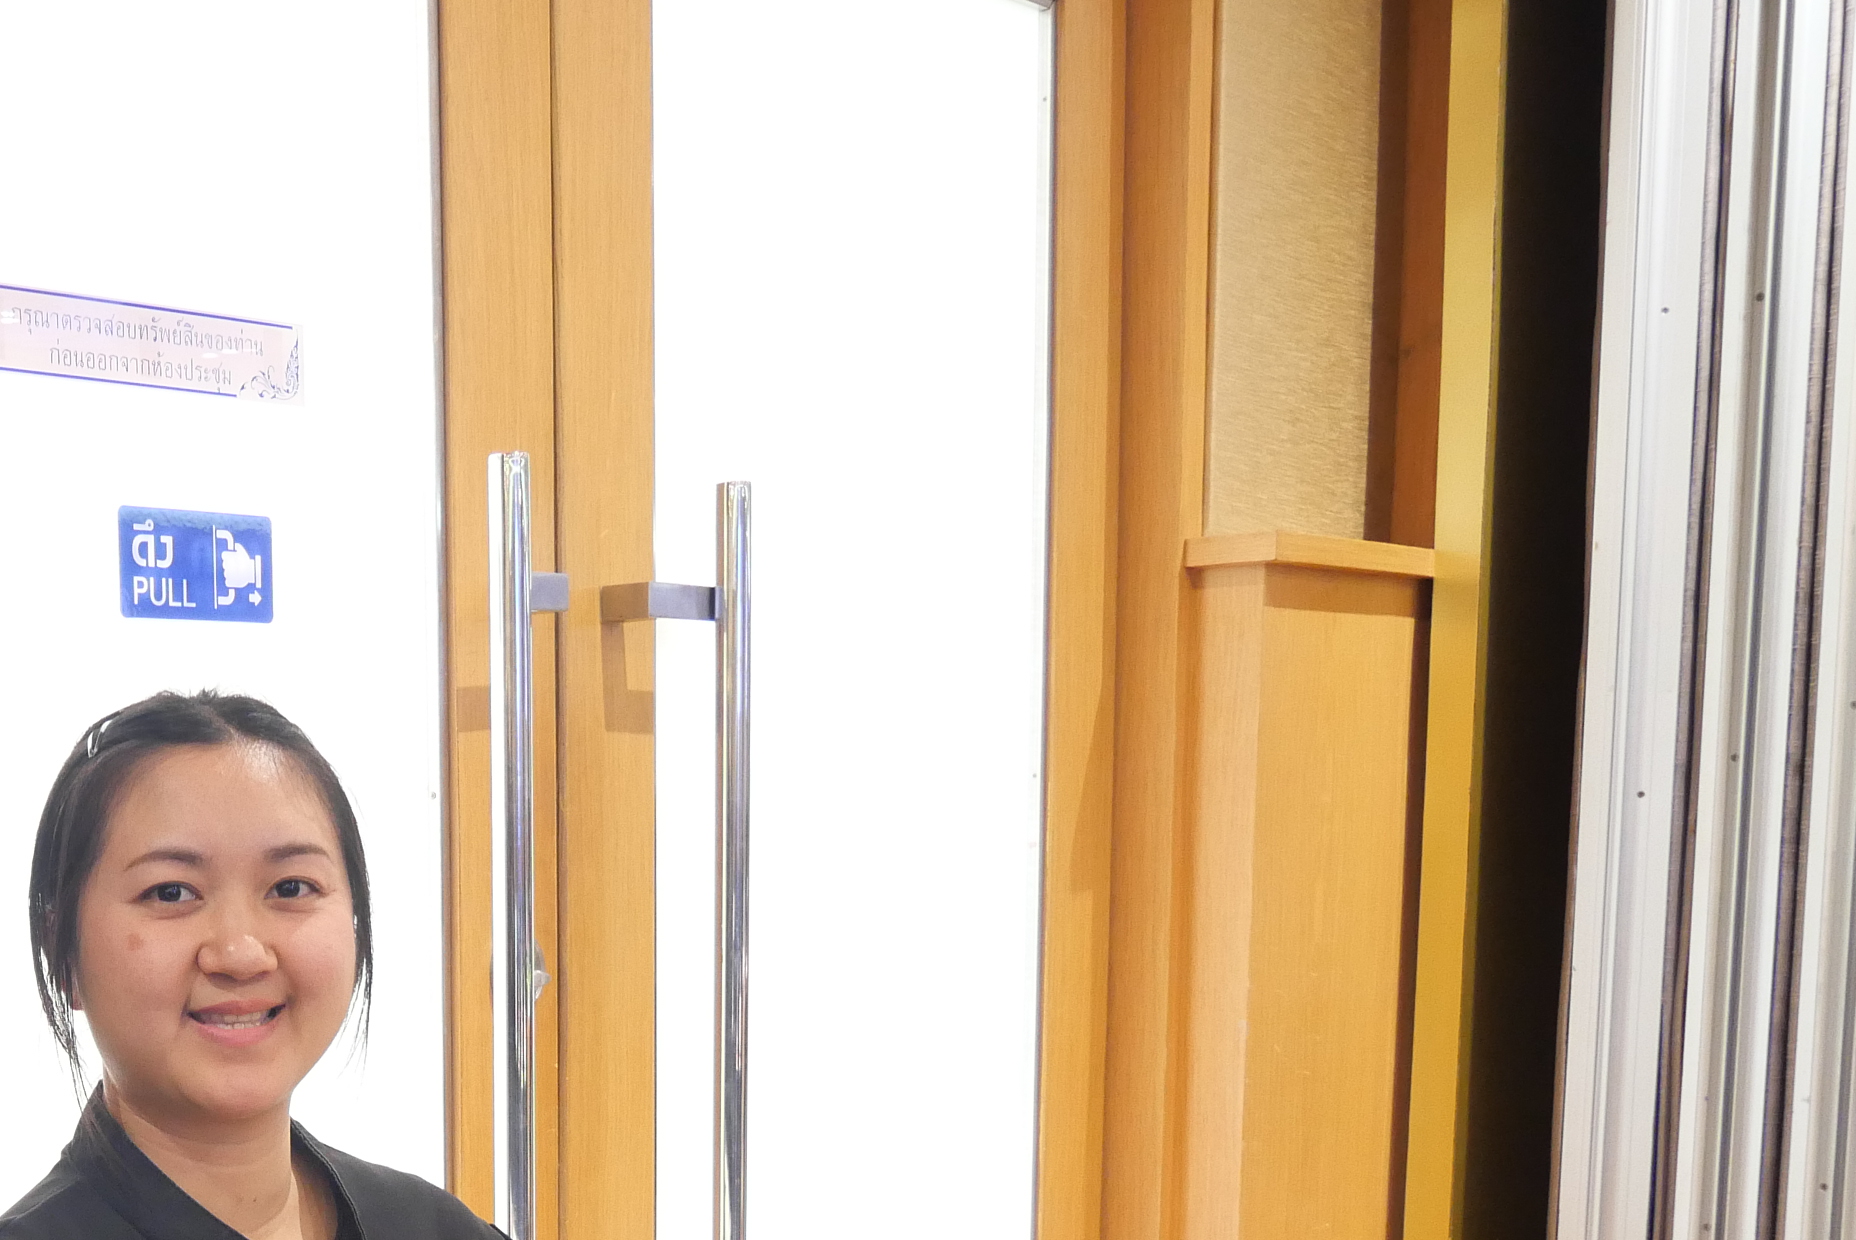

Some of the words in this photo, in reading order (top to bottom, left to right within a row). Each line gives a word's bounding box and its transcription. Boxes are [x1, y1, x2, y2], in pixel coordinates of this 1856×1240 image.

[12, 307, 264, 357] กรุณาตรวจสอบทรัพย์สินของท่าน
[50, 339, 232, 393] ก่อนออกจากห้องประชุม
[132, 519, 174, 568] ดึง
[133, 576, 197, 608] PULL
